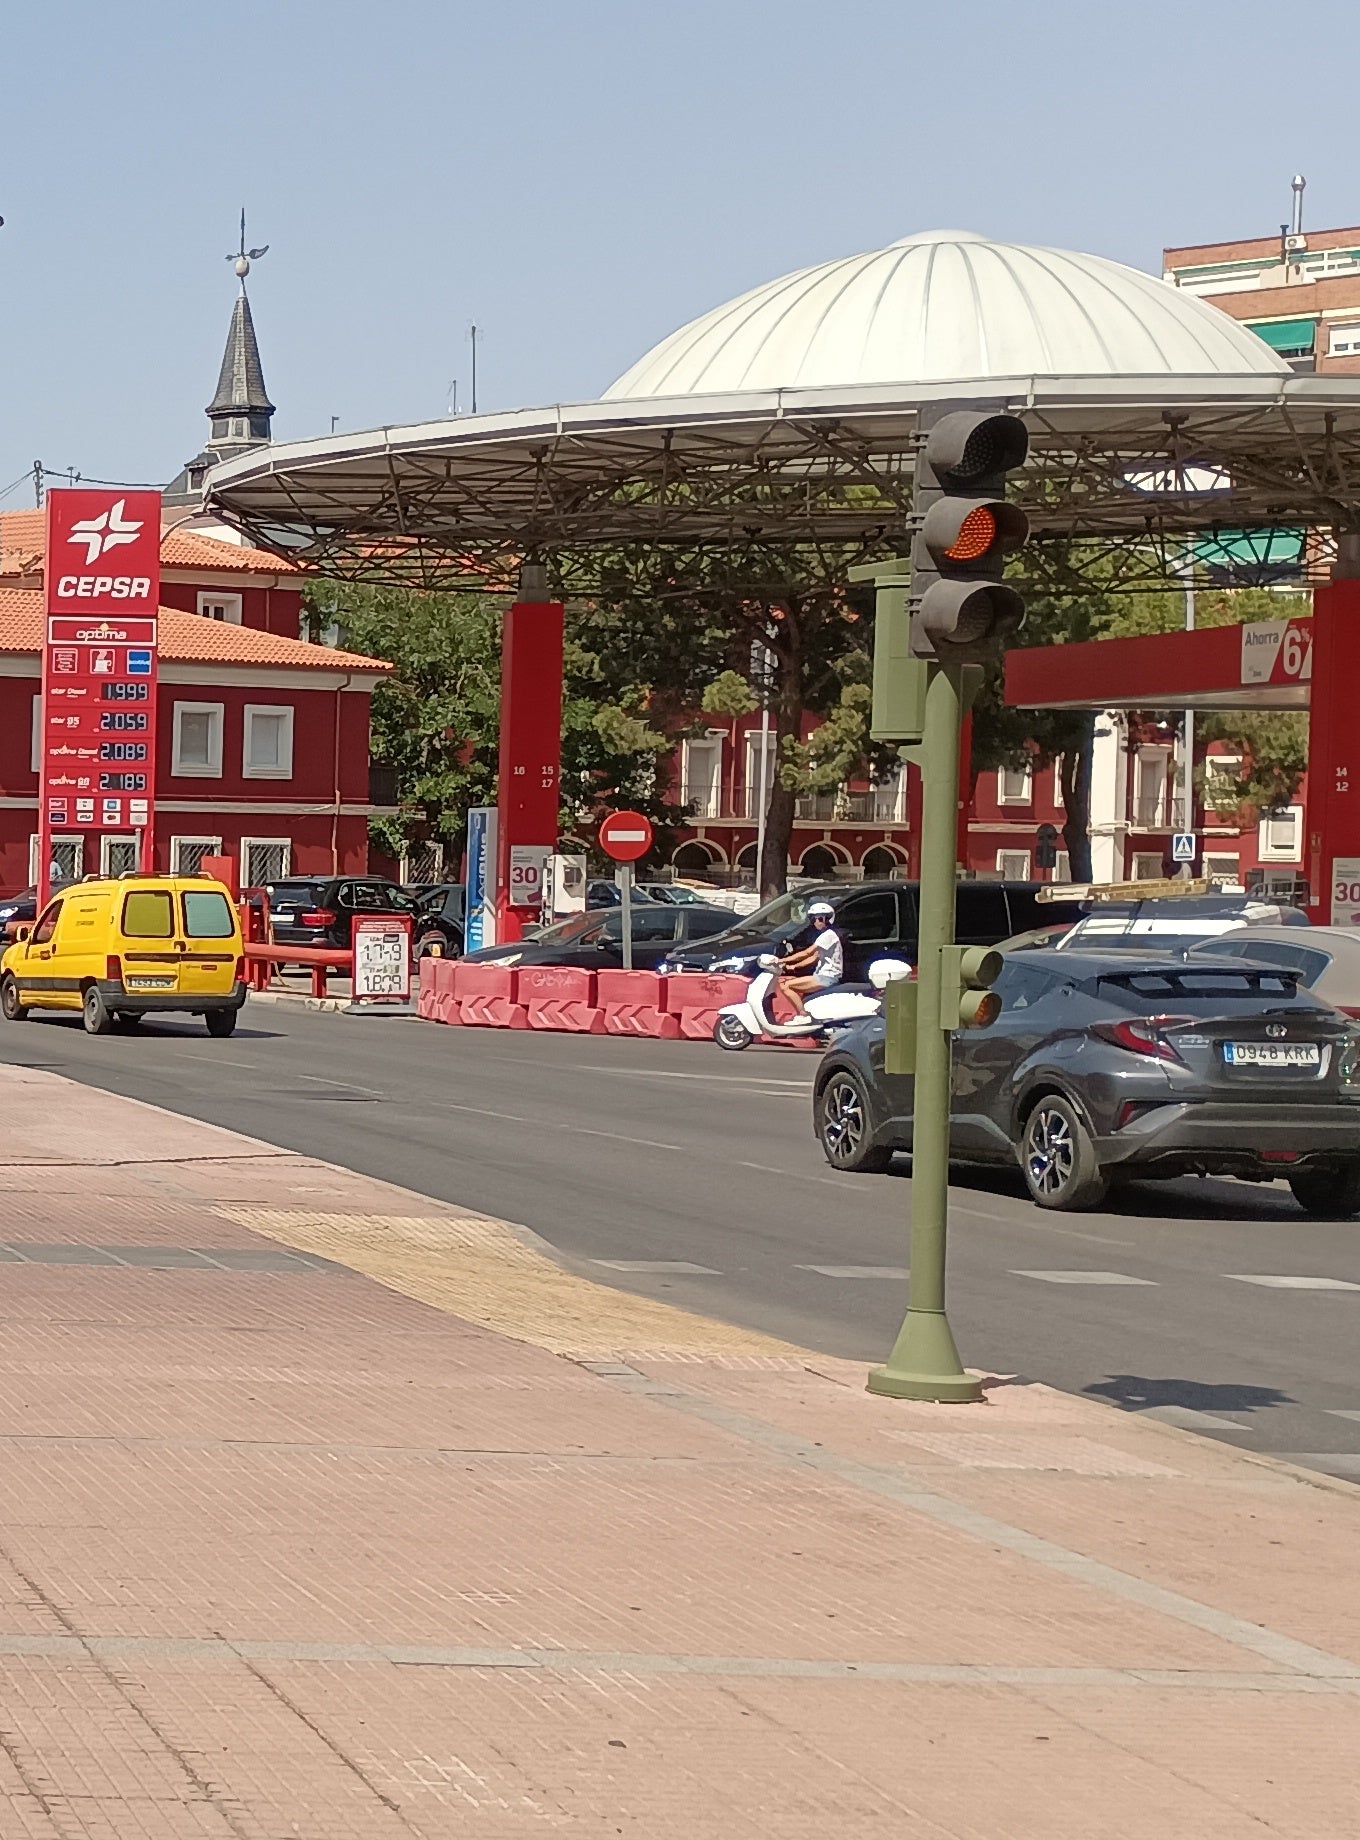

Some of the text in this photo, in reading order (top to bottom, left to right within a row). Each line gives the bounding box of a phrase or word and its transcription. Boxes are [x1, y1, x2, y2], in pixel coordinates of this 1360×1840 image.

[57, 575, 151, 598] CEPSA
[76, 628, 127, 641] optima
[1244, 631, 1280, 646] Ahorra
[107, 683, 148, 700] 1.999
[100, 712, 147, 730] 2.059
[100, 743, 147, 760] 2.089
[1336, 767, 1347, 777] 14
[541, 779, 553, 788] 17
[1336, 782, 1349, 792] 12
[512, 867, 538, 883] 30
[1236, 1044, 1315, 1061] 0948 KRK
